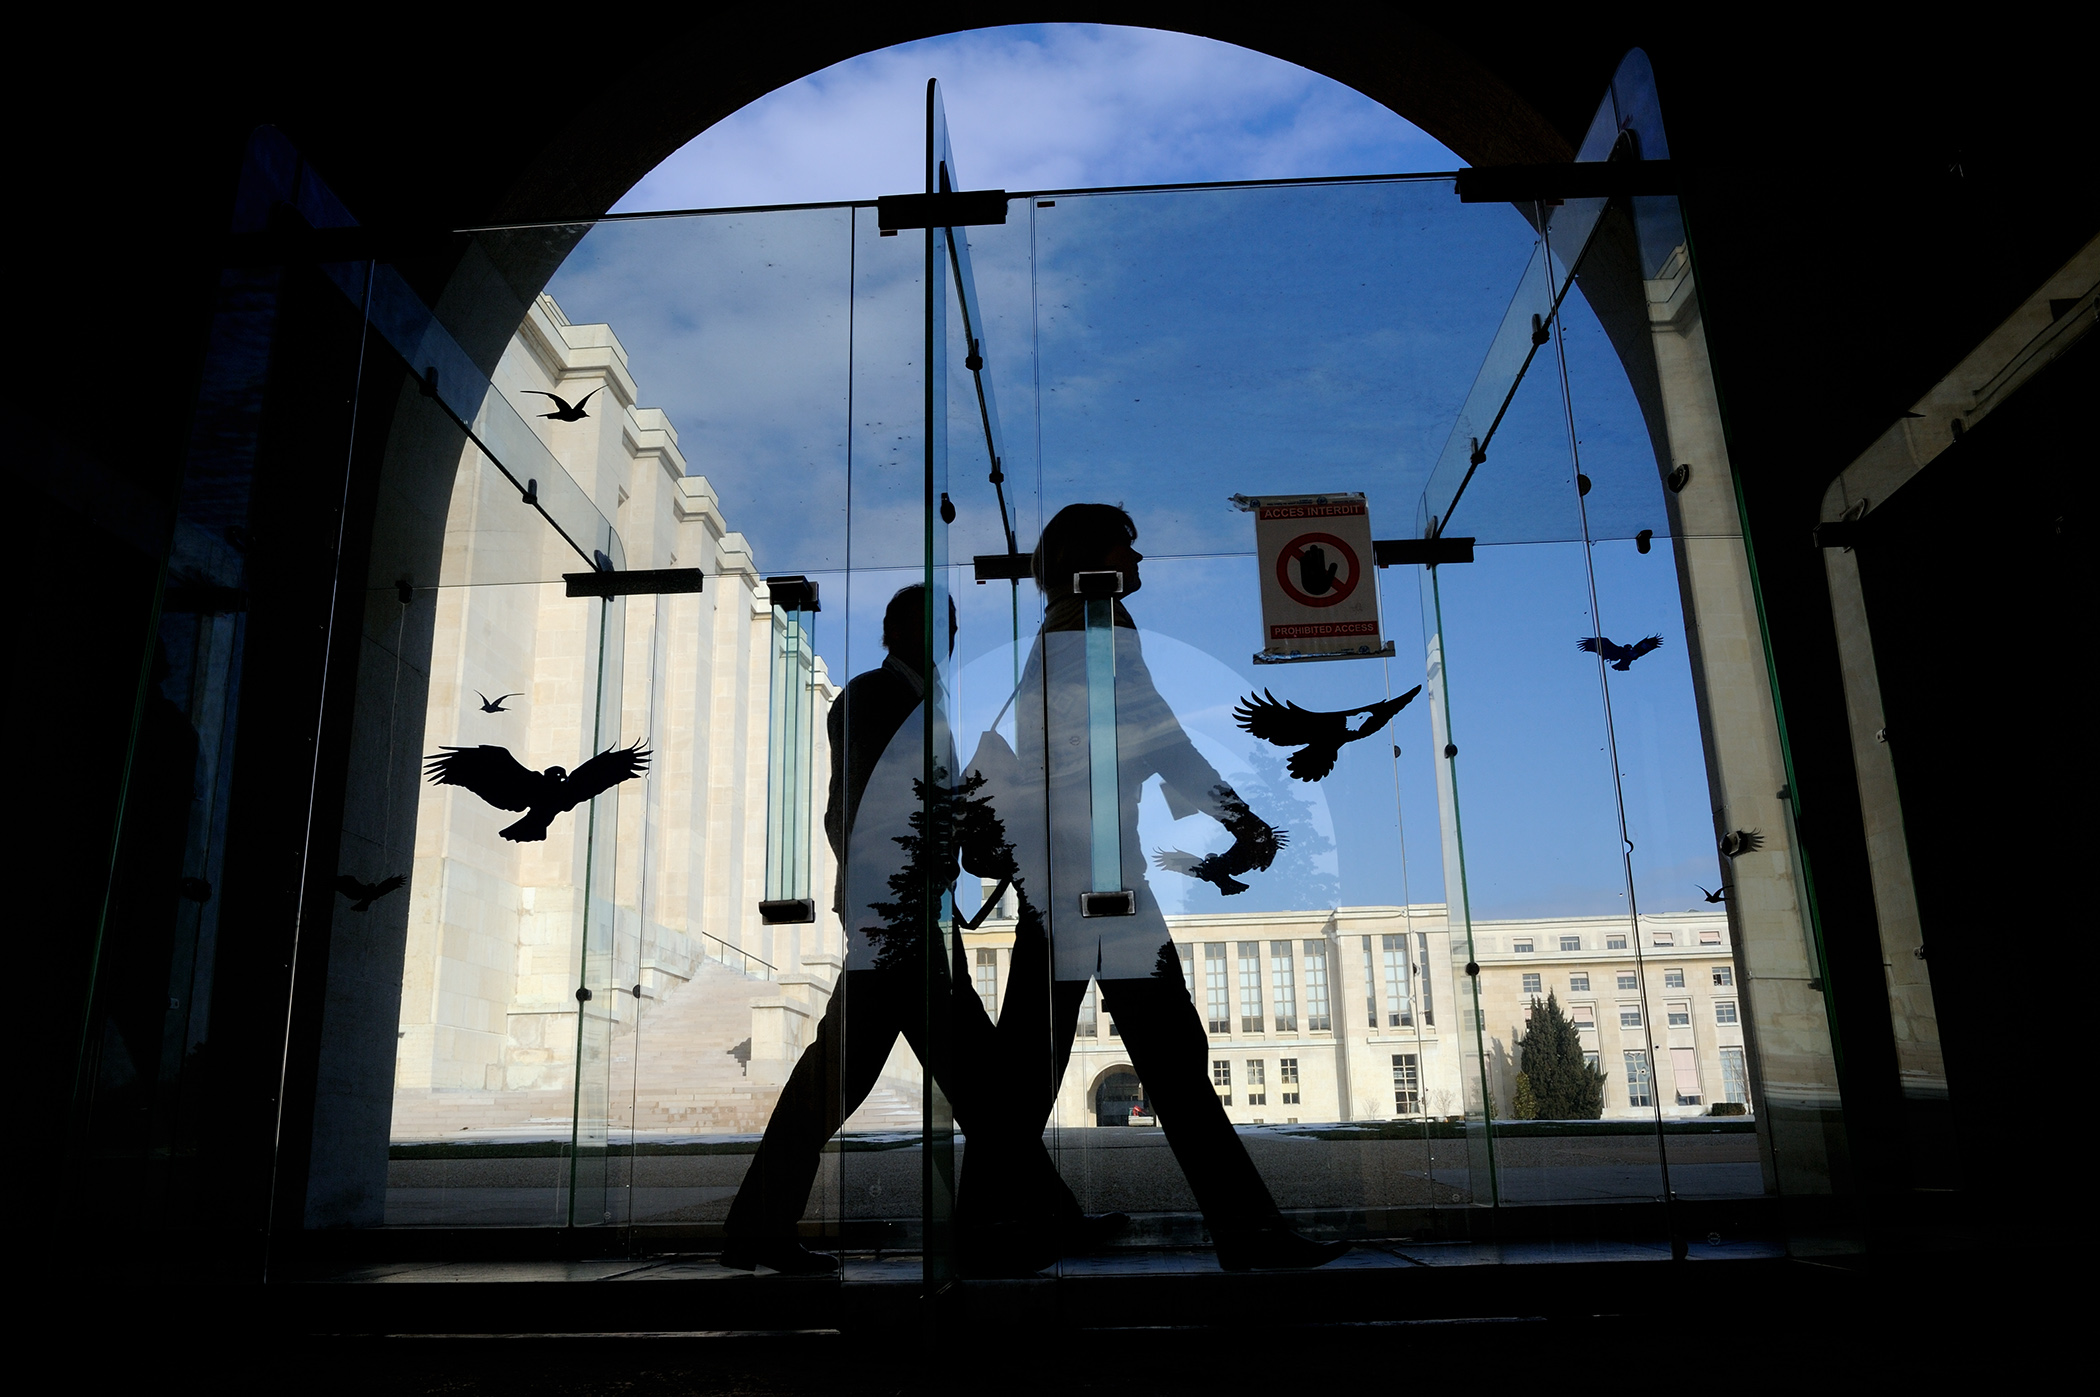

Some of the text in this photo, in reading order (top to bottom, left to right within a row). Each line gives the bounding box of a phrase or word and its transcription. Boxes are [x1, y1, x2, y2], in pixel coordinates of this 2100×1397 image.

[1264, 505, 1360, 519] ACCES INTERDIT
[1275, 623, 1374, 635] PROHIBITED ACCESS
